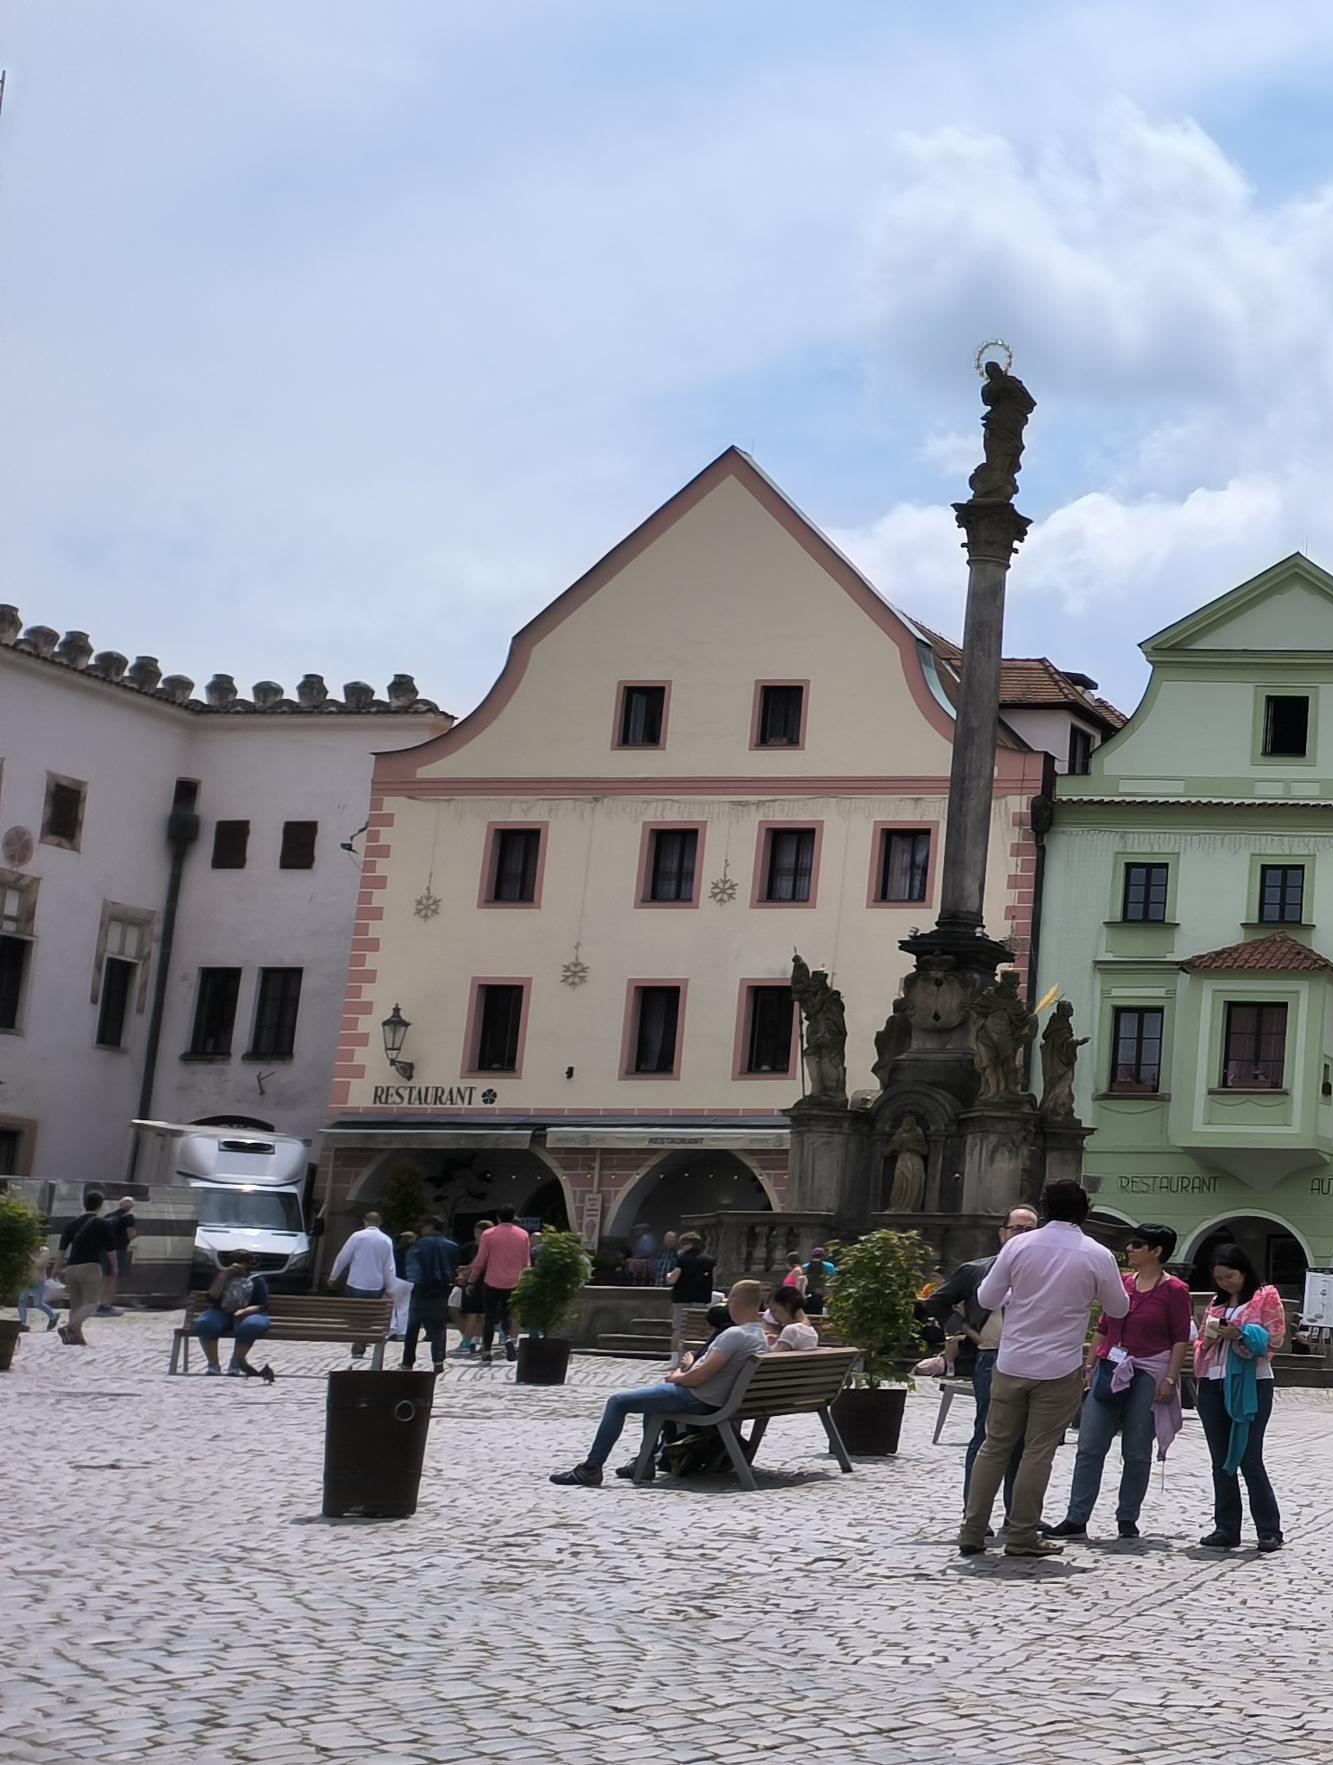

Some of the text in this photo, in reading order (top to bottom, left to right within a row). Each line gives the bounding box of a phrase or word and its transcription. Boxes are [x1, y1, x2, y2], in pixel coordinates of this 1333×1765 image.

[372, 1085, 477, 1106] RESTAURANT
[647, 1136, 706, 1146] RESTAURANT
[1117, 1175, 1220, 1195] RESTAURANT
